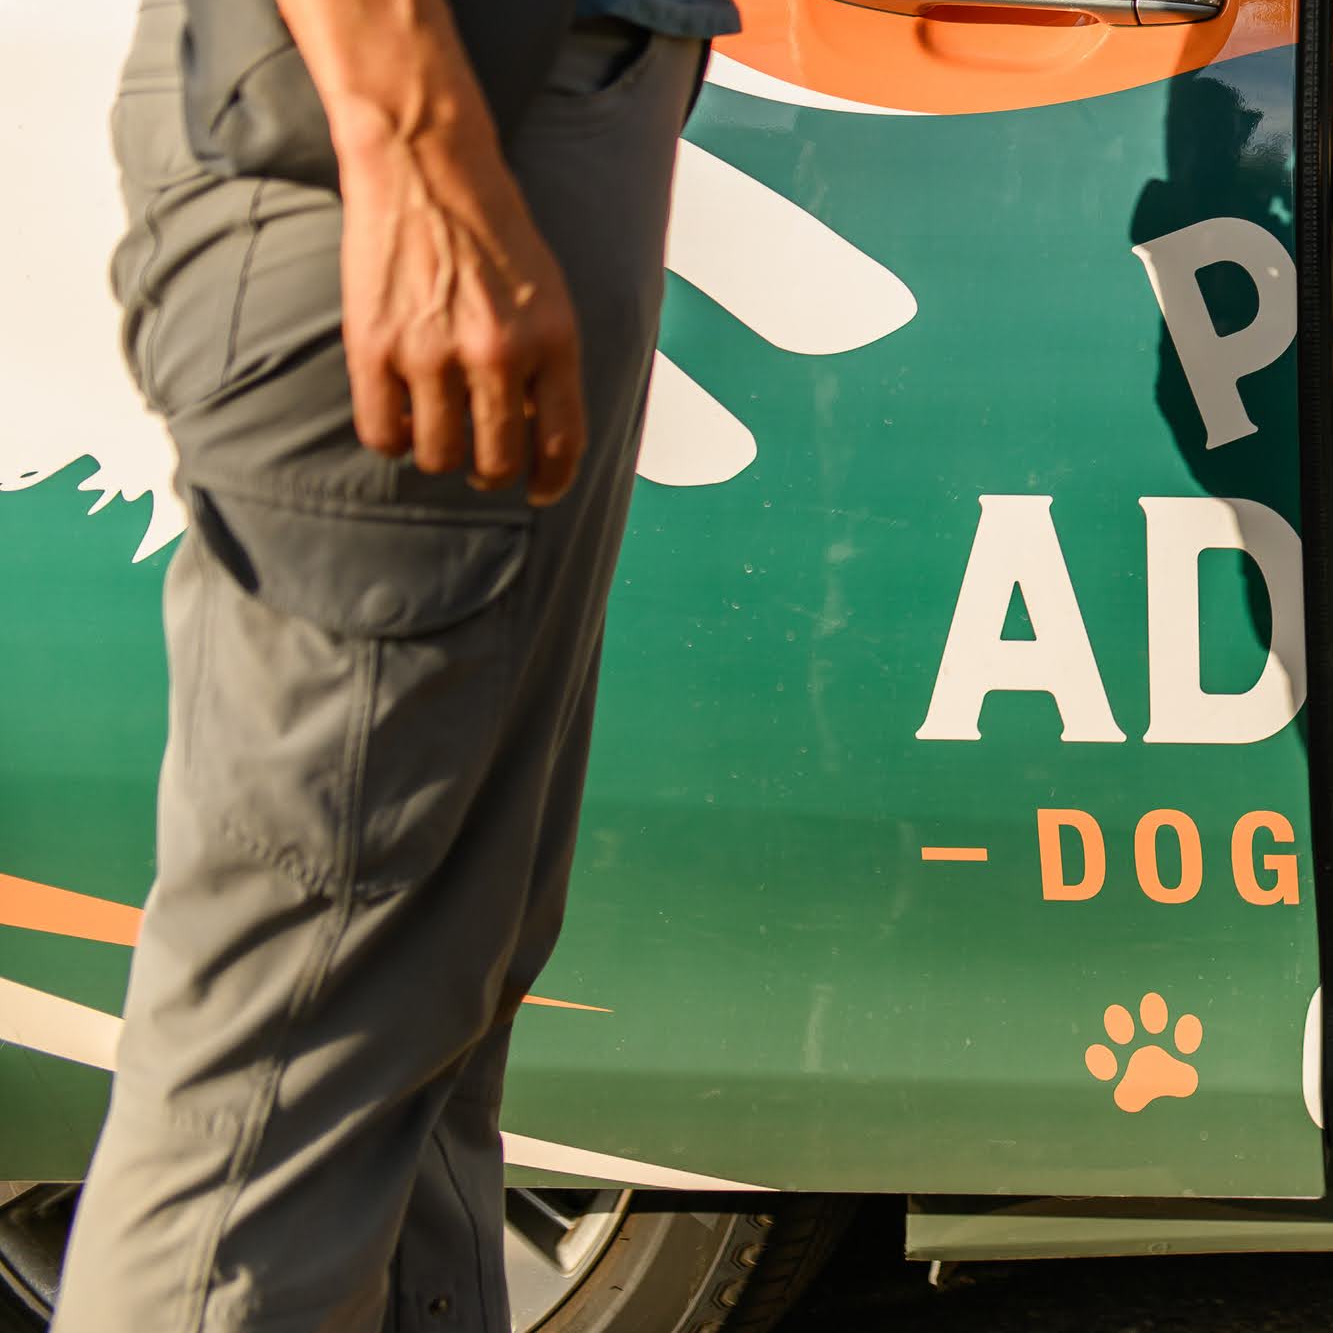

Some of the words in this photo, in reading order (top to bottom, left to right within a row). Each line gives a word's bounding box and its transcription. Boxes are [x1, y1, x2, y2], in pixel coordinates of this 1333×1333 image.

[1131, 217, 1297, 450] P
[914, 494, 1307, 744] AD
[1037, 808, 1300, 906] DOG
